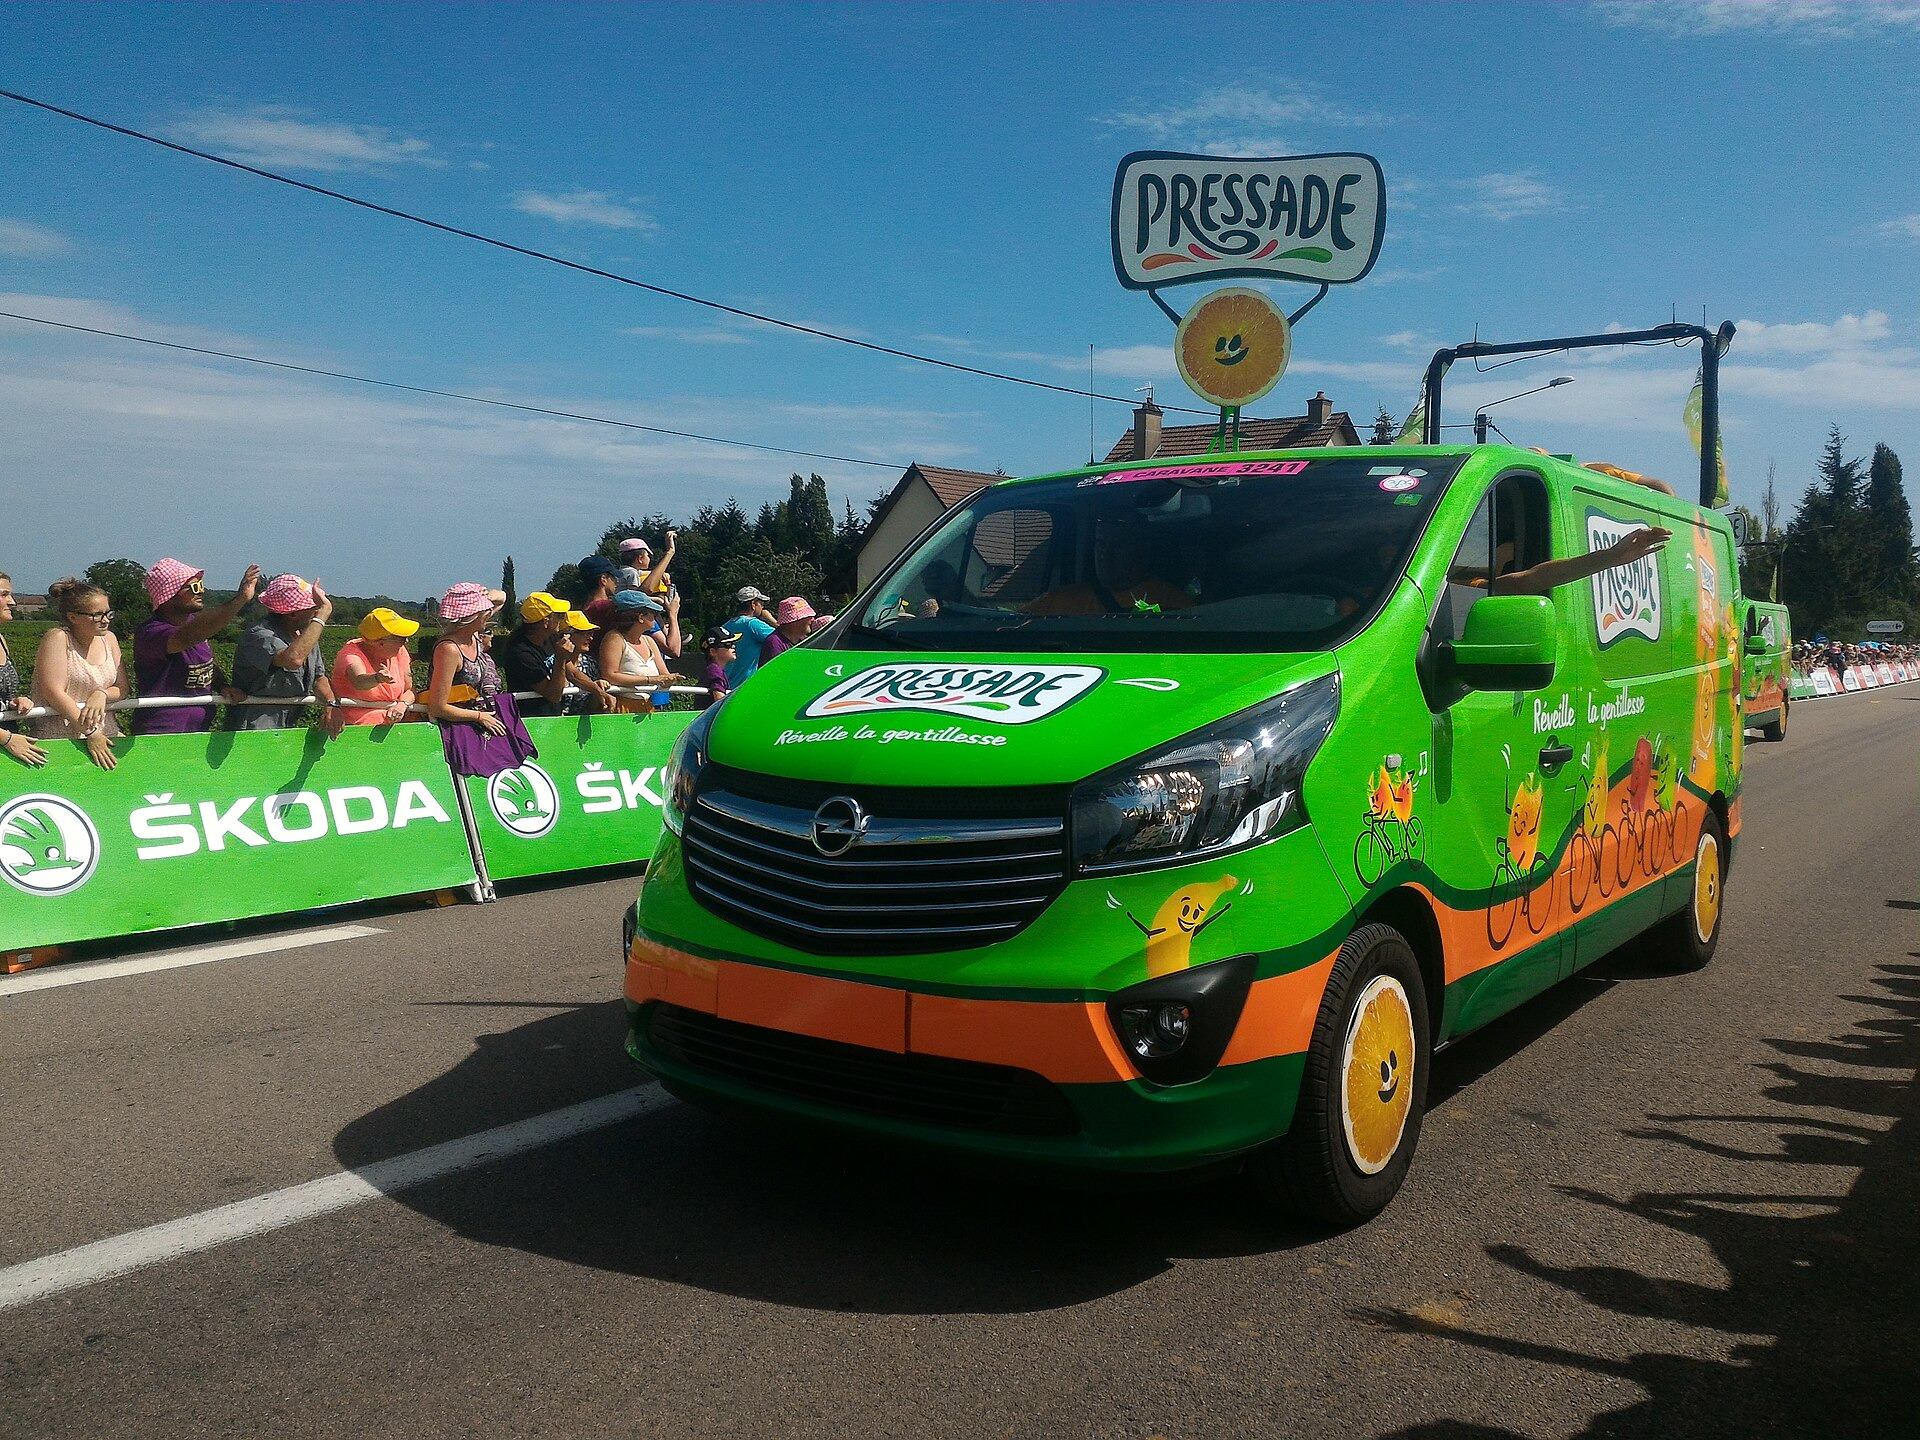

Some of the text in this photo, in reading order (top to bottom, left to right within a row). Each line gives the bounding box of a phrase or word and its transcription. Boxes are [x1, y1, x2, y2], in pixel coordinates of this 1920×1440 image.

[1136, 173, 1362, 256] PRESSADE
[1132, 462, 1301, 478] CARAVANE 3241
[827, 668, 1085, 707] PRESSADE
[1533, 685, 1646, 735] Réveille la gentillesse
[774, 724, 1008, 746] Réveille la gentillesse
[575, 761, 667, 814] ŠK
[129, 780, 452, 861] ŠKODA
